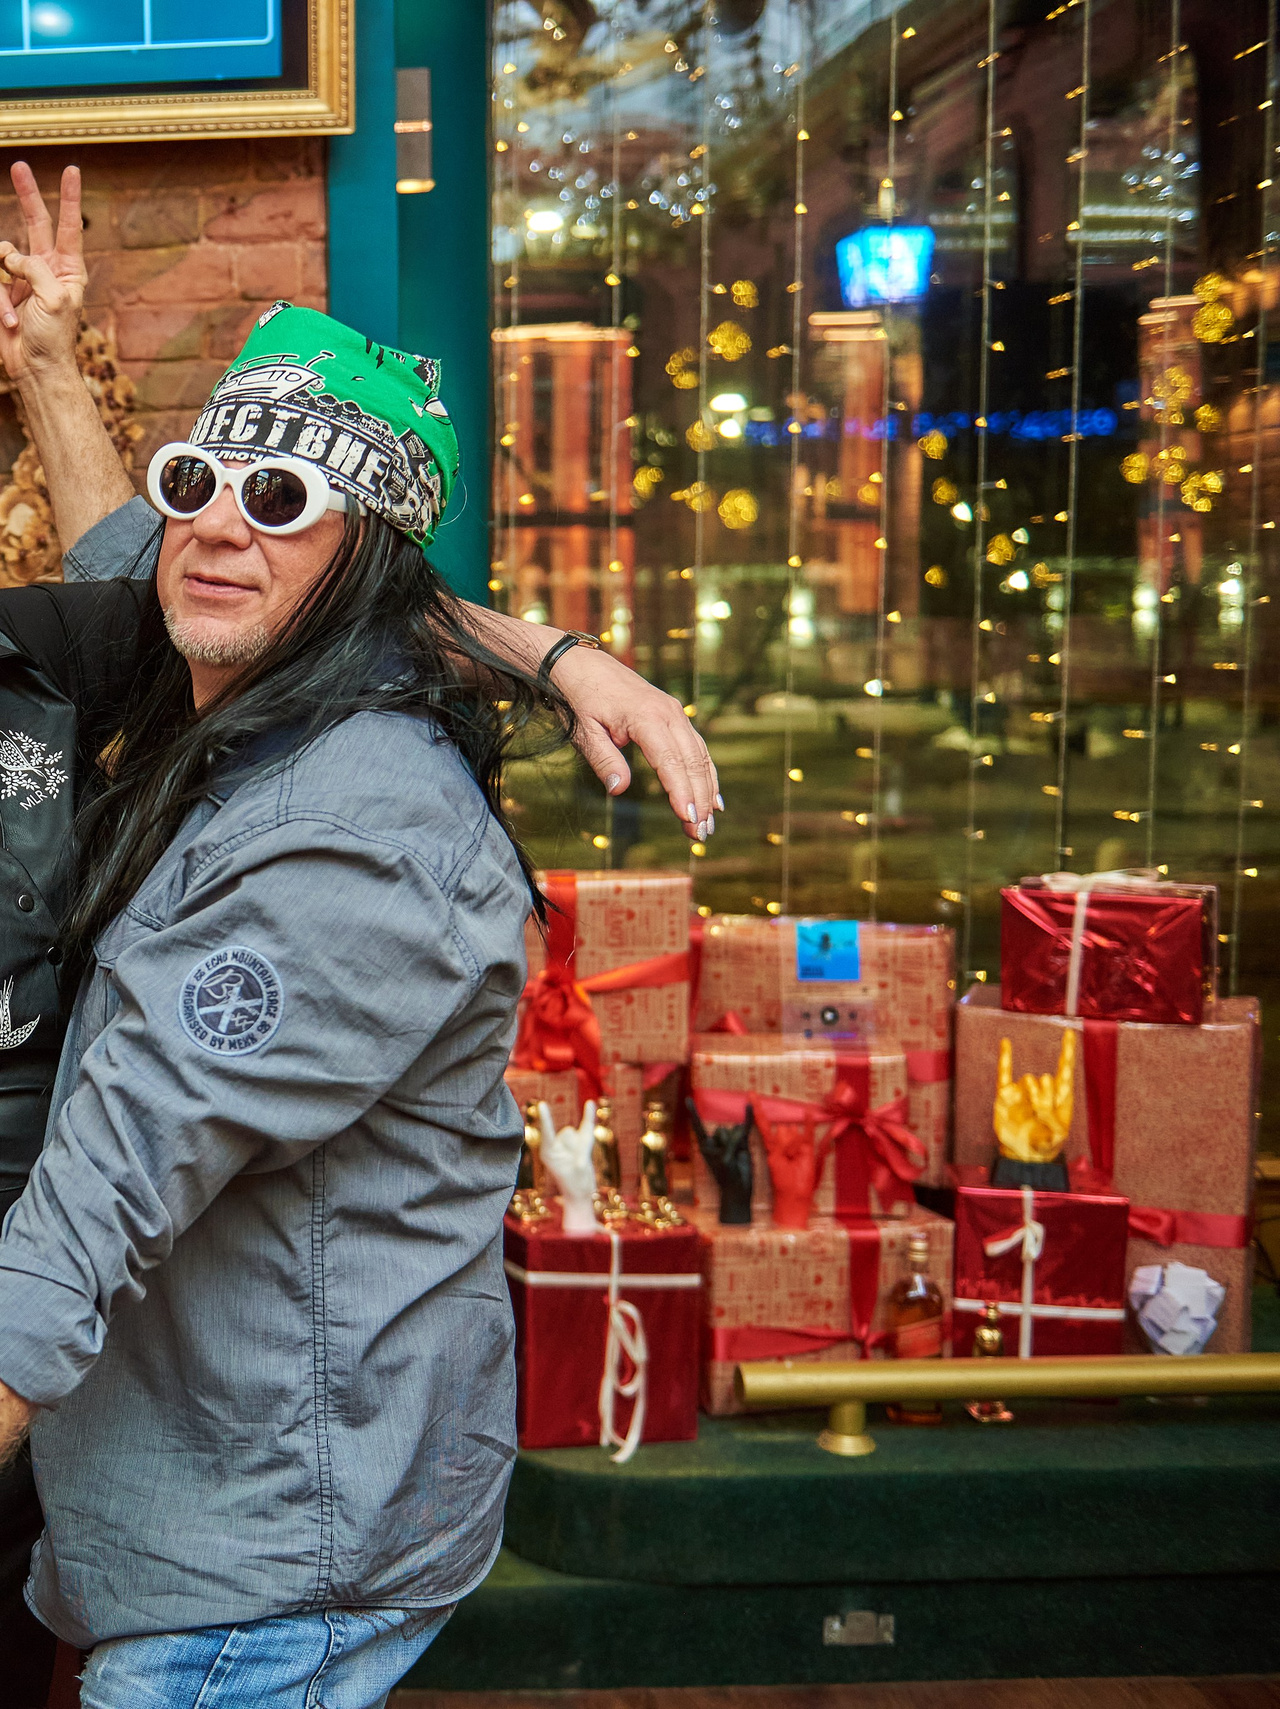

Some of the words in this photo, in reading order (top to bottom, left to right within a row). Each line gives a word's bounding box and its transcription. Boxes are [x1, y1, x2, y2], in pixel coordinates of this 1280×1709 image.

[188, 403, 391, 492] ШЕСТВИЕ
[20, 790, 48, 810] MLR
[205, 952, 228, 970] ECHO
[232, 951, 276, 989] MOUNTAIN
[264, 991, 279, 1019] RACE
[209, 1035, 225, 1050] BY
